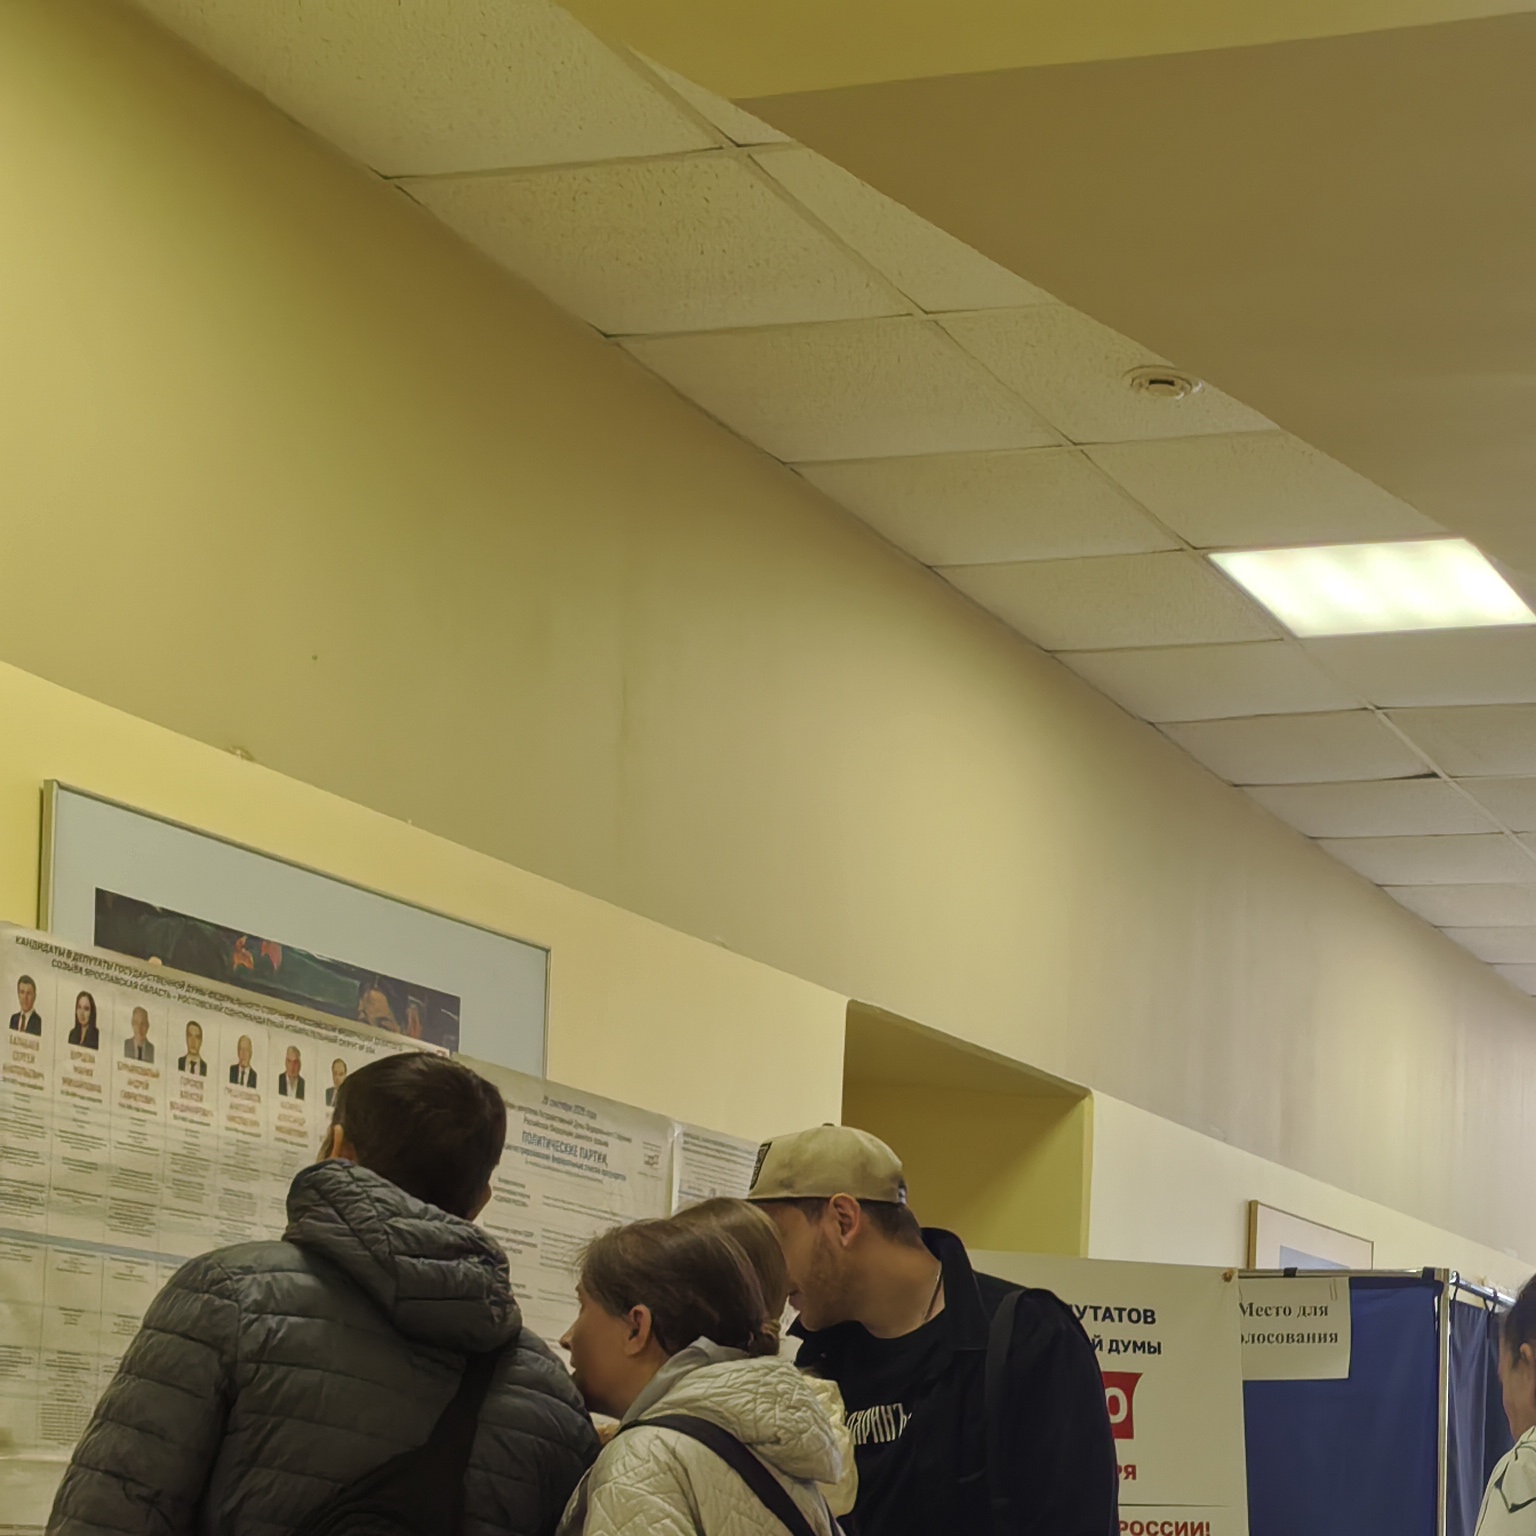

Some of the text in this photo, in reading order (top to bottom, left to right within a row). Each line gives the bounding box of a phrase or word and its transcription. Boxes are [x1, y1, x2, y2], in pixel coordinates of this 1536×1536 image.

[1070, 1304, 1156, 1324] УТАТОВ
[1297, 1305, 1328, 1318] для
[1241, 1332, 1338, 1345] лосования
[1108, 1339, 1162, 1355] ДУМЫ
[1104, 1386, 1128, 1424] 0
